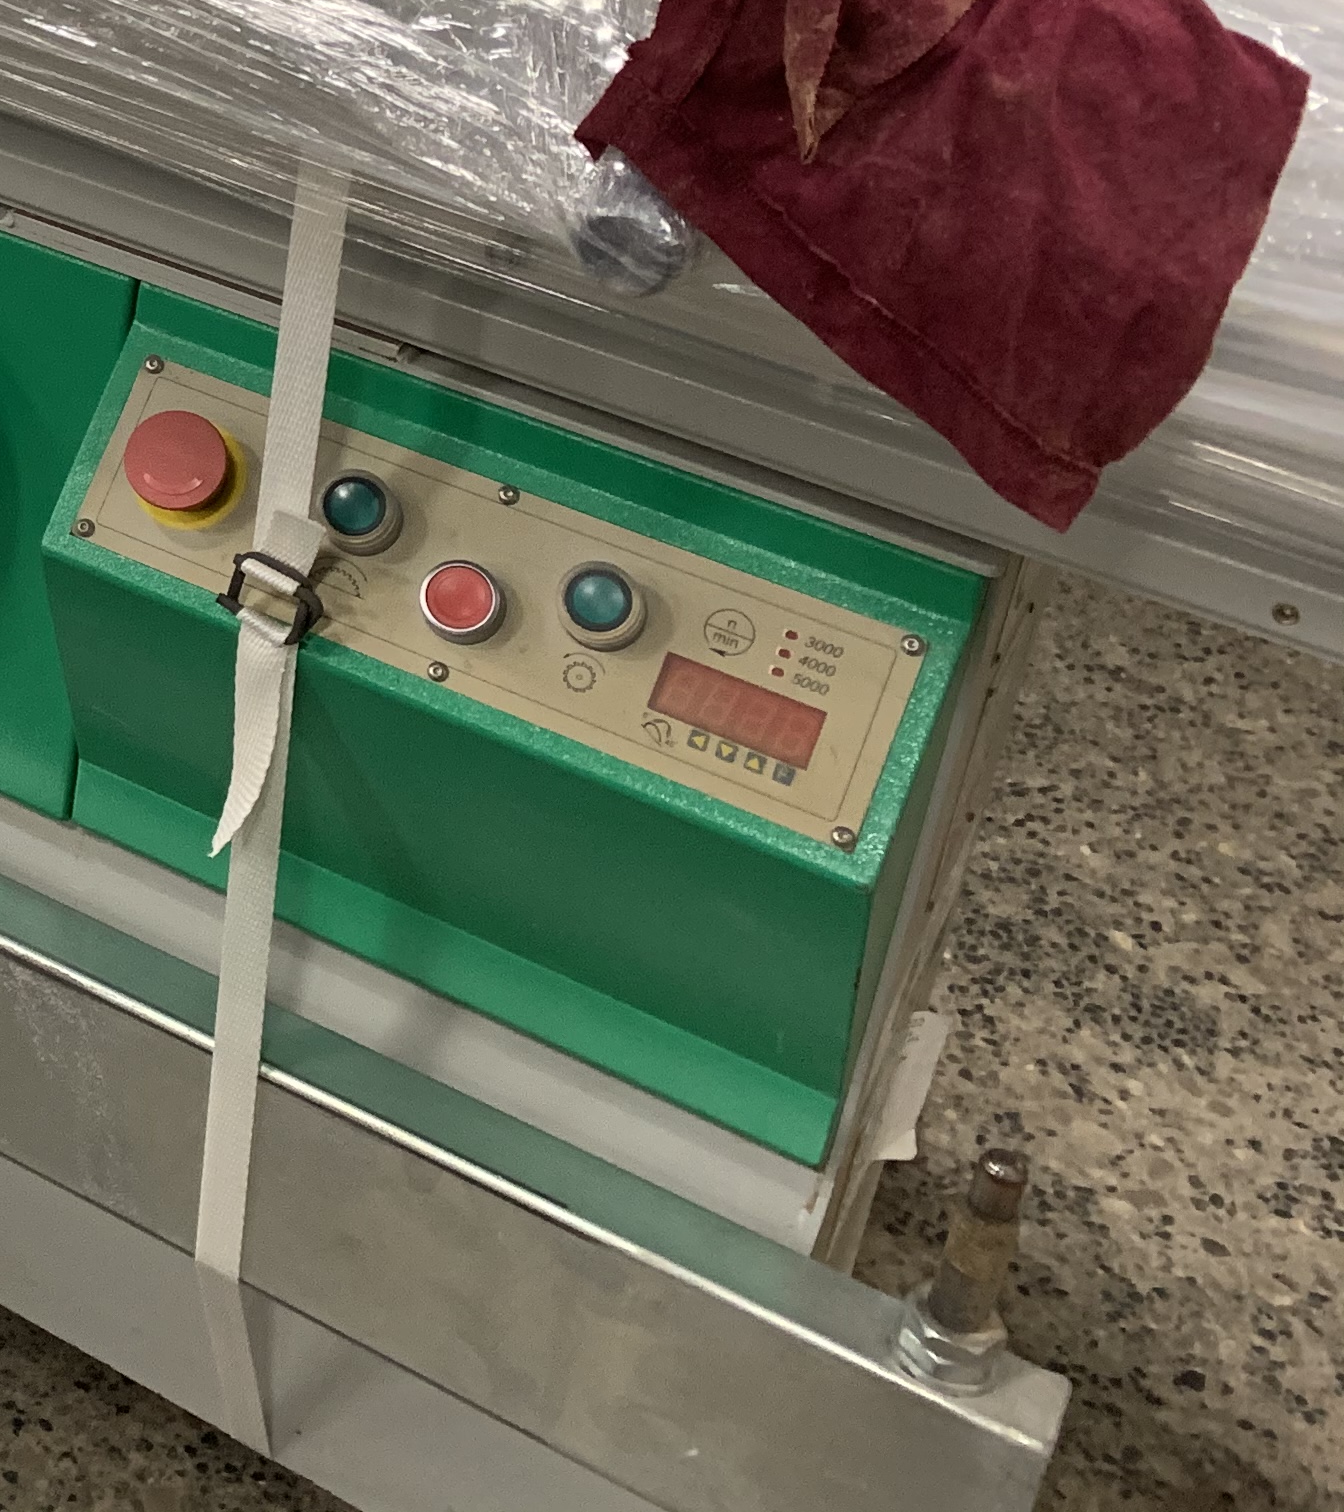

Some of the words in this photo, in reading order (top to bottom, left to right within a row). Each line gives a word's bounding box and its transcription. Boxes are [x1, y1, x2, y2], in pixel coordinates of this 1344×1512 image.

[712, 631, 740, 650] min
[804, 636, 845, 659] 3000
[798, 655, 837, 677] 4000
[792, 672, 831, 697] 5000
